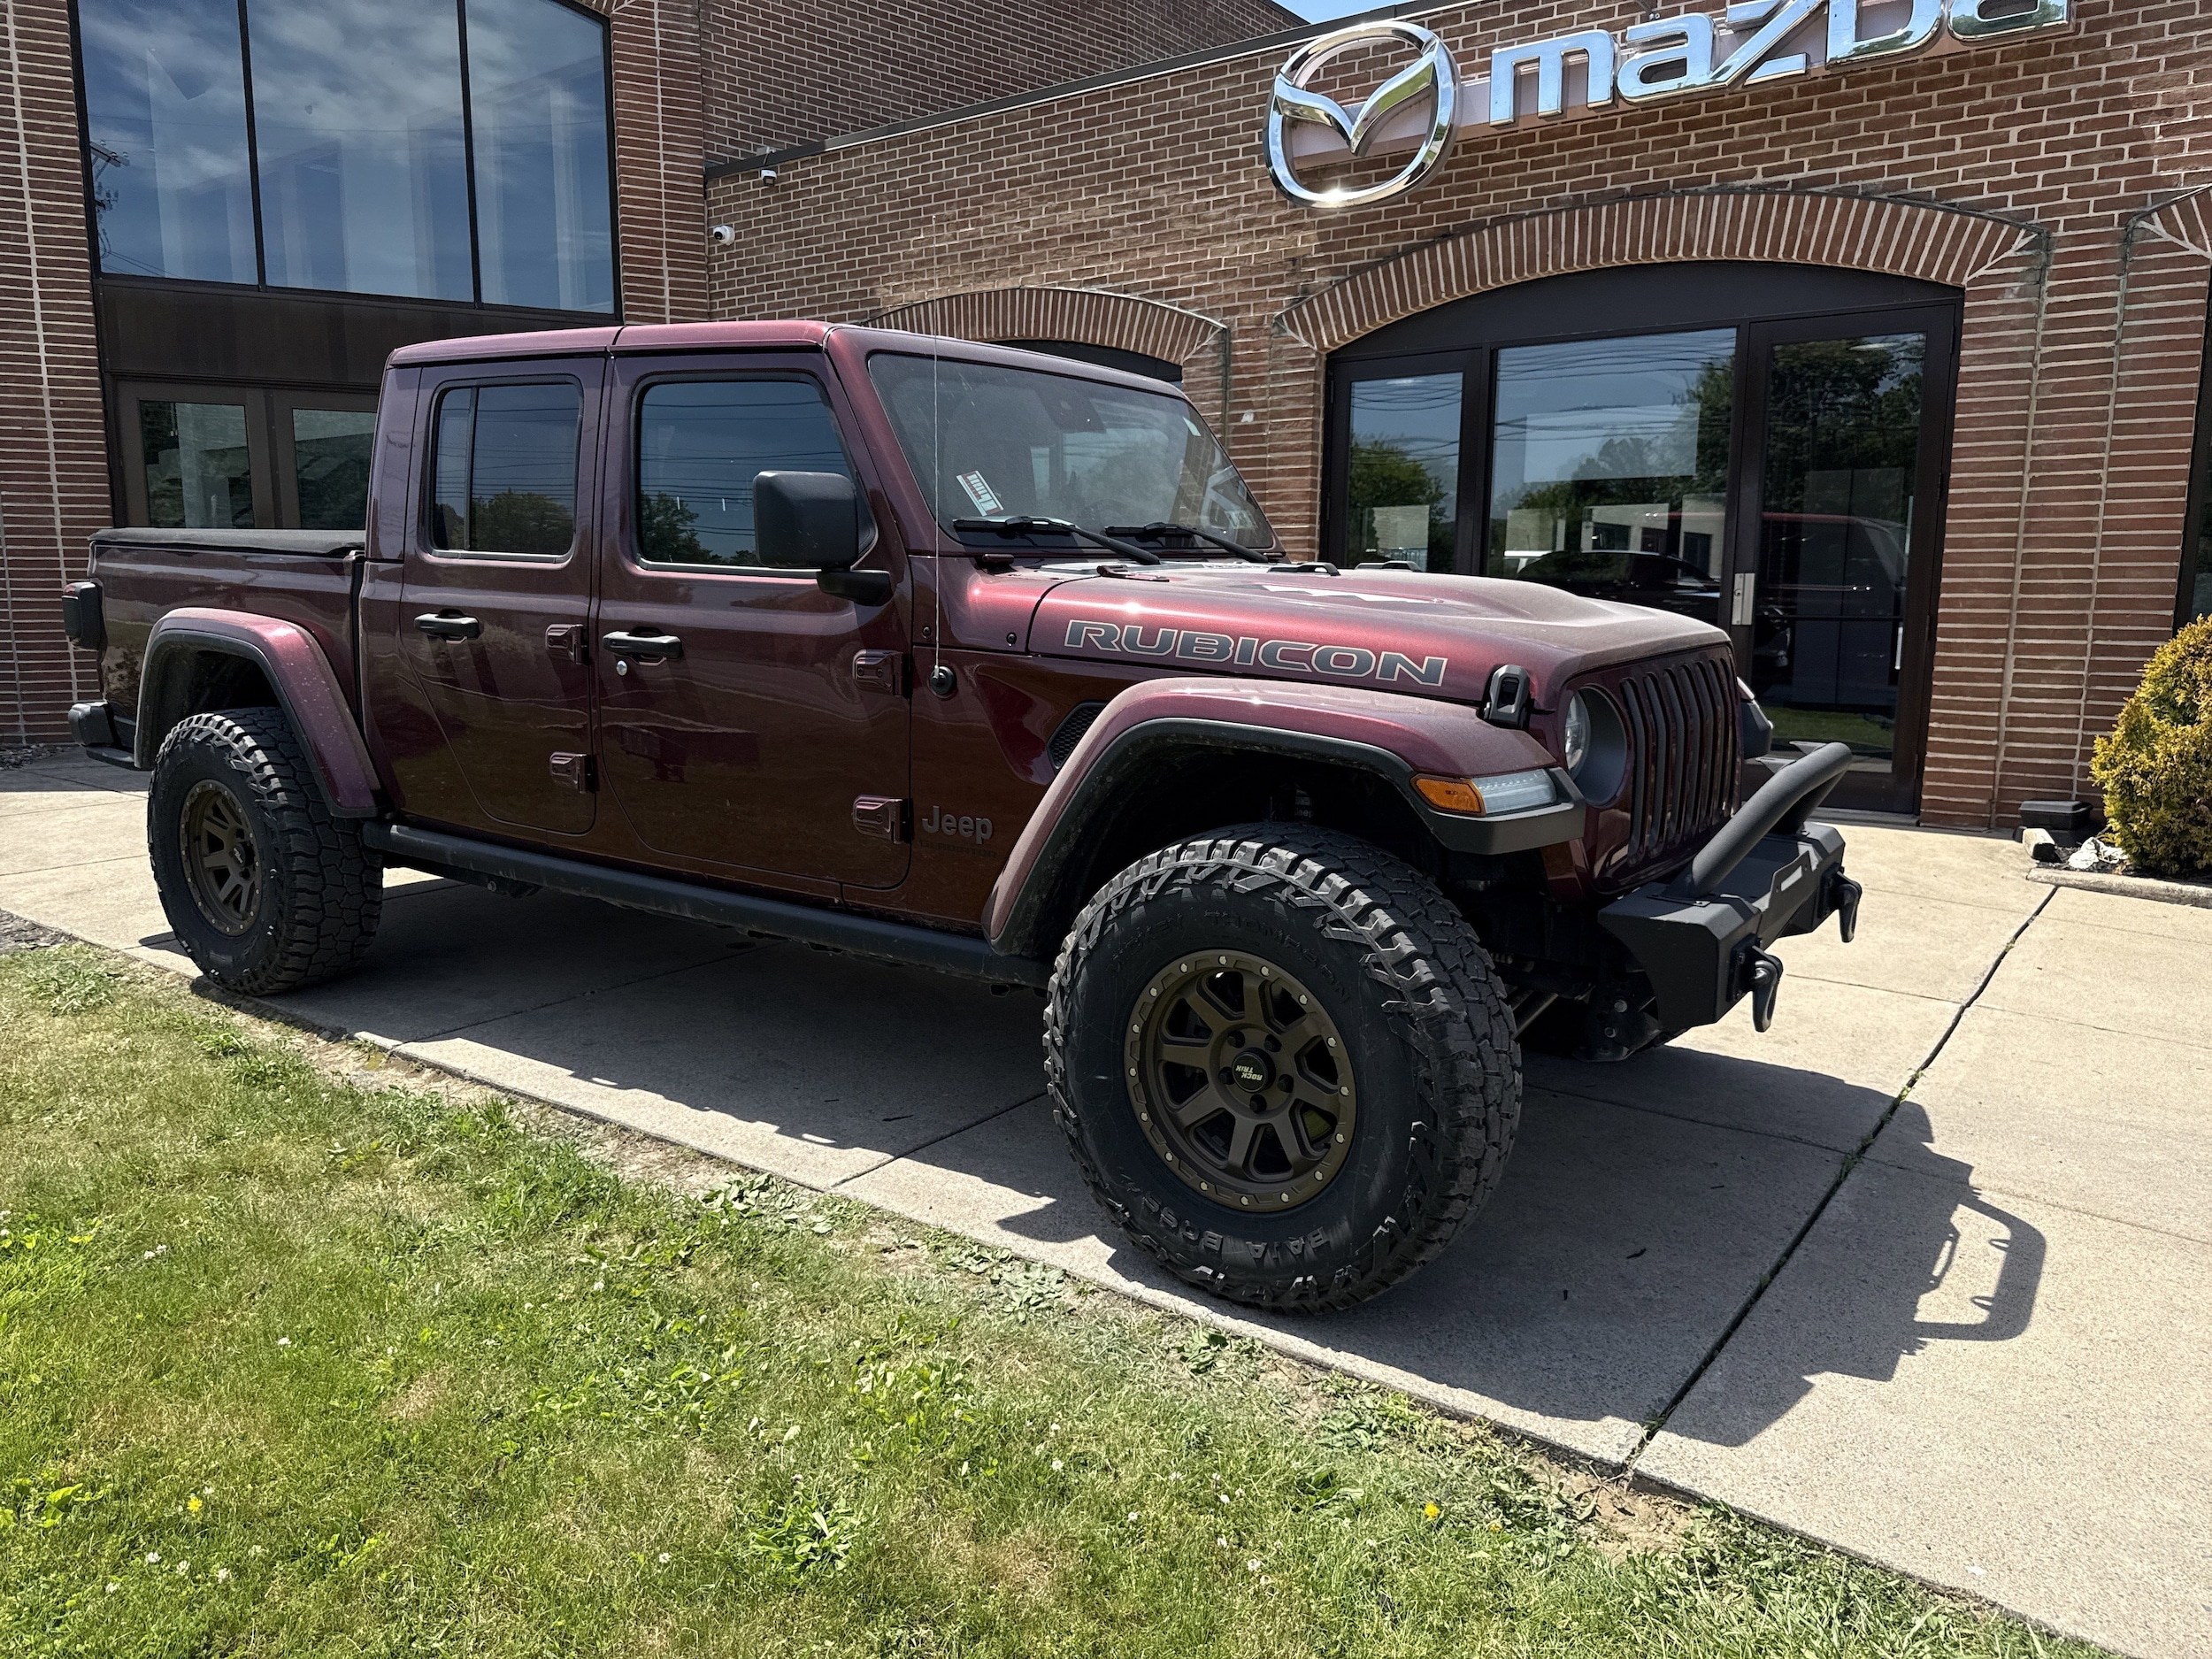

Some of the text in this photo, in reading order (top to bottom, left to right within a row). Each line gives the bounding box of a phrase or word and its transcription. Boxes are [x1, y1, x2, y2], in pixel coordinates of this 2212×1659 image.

[1064, 619, 1448, 687] RUBICON
[922, 805, 993, 845] Jeep
[1240, 1071, 1263, 1081] ROCK
[1141, 1191, 1331, 1260] BAJA BOSS
